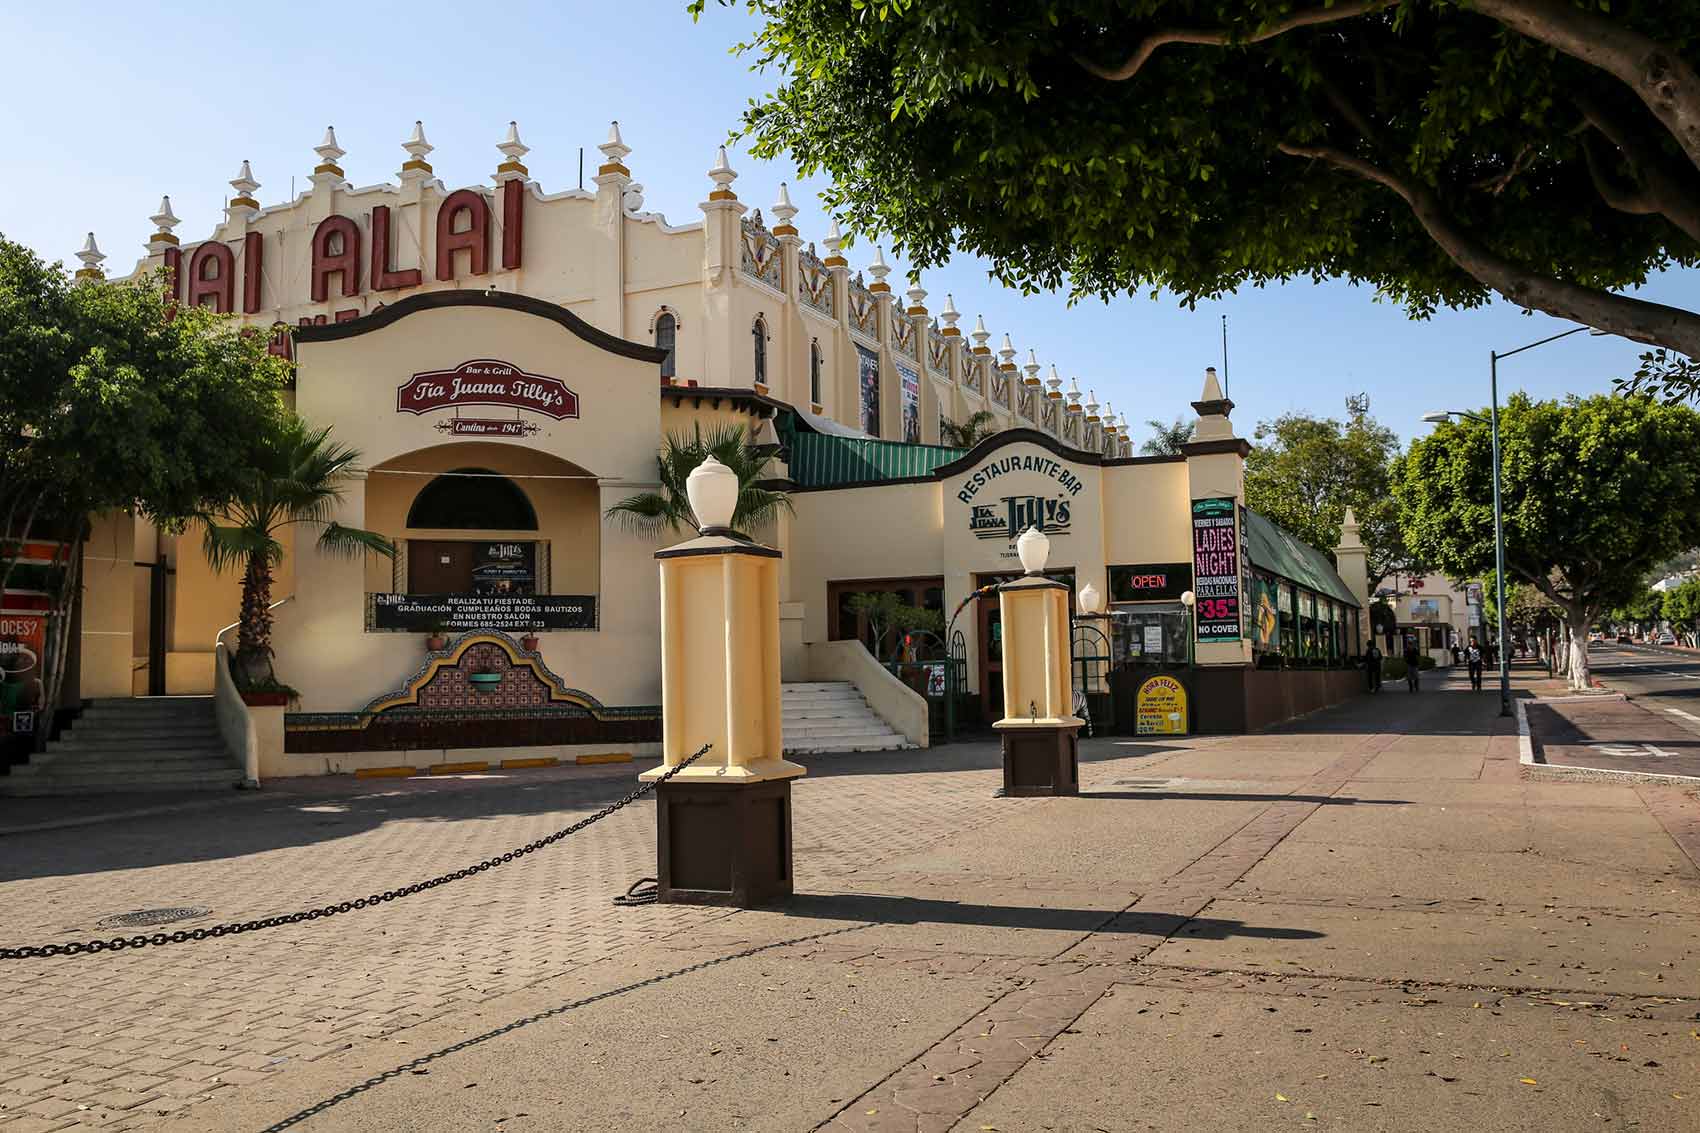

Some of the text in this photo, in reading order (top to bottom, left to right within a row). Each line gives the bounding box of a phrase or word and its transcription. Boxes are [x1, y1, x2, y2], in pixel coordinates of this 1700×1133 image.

[310, 179, 523, 302] ALAI
[466, 366, 481, 375] Bar
[492, 367, 512, 375] Grill
[450, 377, 506, 401] Juana
[510, 380, 563, 407] Tilly's
[455, 422, 486, 433] Cantina
[501, 423, 522, 433] 1947
[1195, 528, 1234, 552] LADIES
[1196, 552, 1235, 576] NIGHT
[1133, 576, 1166, 588] OPEN
[1196, 585, 1238, 597] PARA ELLAS
[398, 604, 452, 612] GRADUACIÓN
[457, 604, 511, 613] CUMPLEAÑOS
[1198, 624, 1238, 633] NO COVER
[1143, 679, 1179, 695] HORA FELIZ
